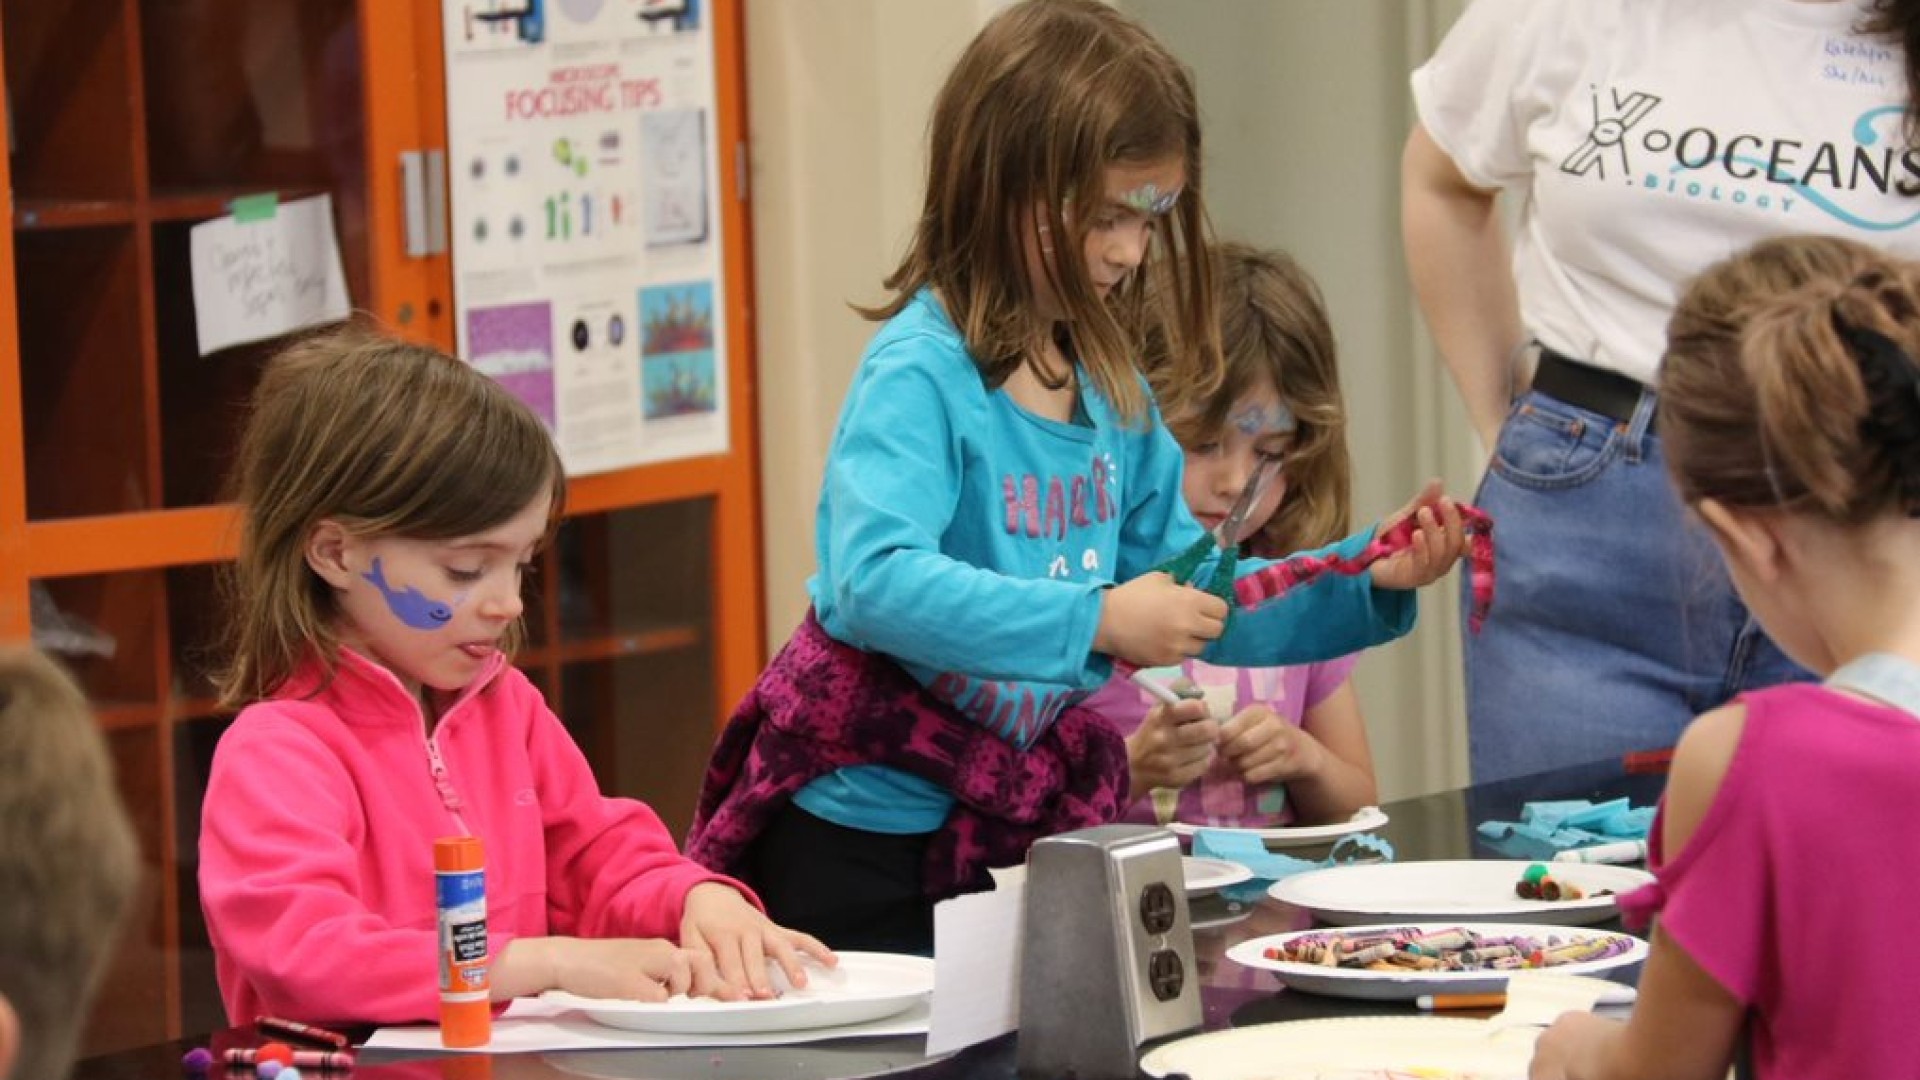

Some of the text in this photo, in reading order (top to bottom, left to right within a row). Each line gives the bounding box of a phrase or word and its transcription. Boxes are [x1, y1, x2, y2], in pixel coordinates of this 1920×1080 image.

[504, 78, 662, 121] FOCUSING TIPS
[1675, 127, 1920, 197] OCEANS
[1643, 173, 1796, 212] BIOLOGY
